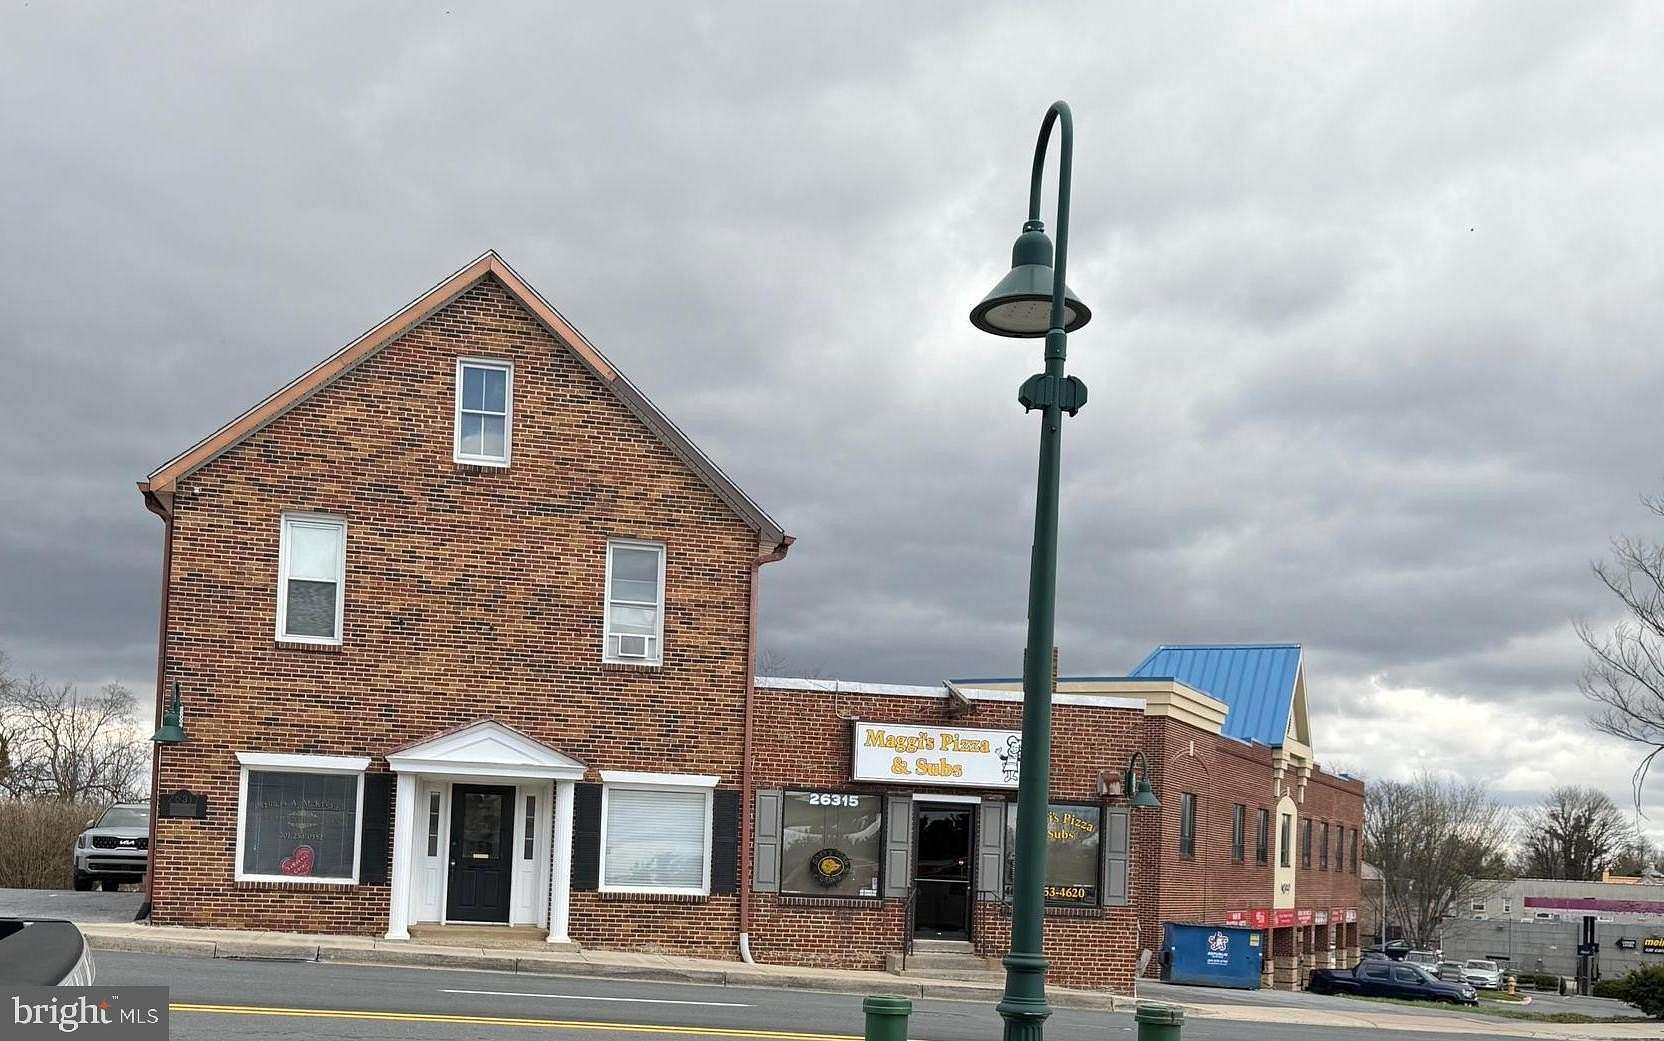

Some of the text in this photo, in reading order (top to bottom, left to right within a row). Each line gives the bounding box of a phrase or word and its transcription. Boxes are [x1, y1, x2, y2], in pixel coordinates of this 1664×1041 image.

[864, 729, 991, 753] Maggi's Pizza
[890, 756, 963, 777] & Subs
[809, 793, 859, 807] 26315
[1062, 813, 1094, 832] Pizza
[1044, 887, 1085, 898] 53-4620
